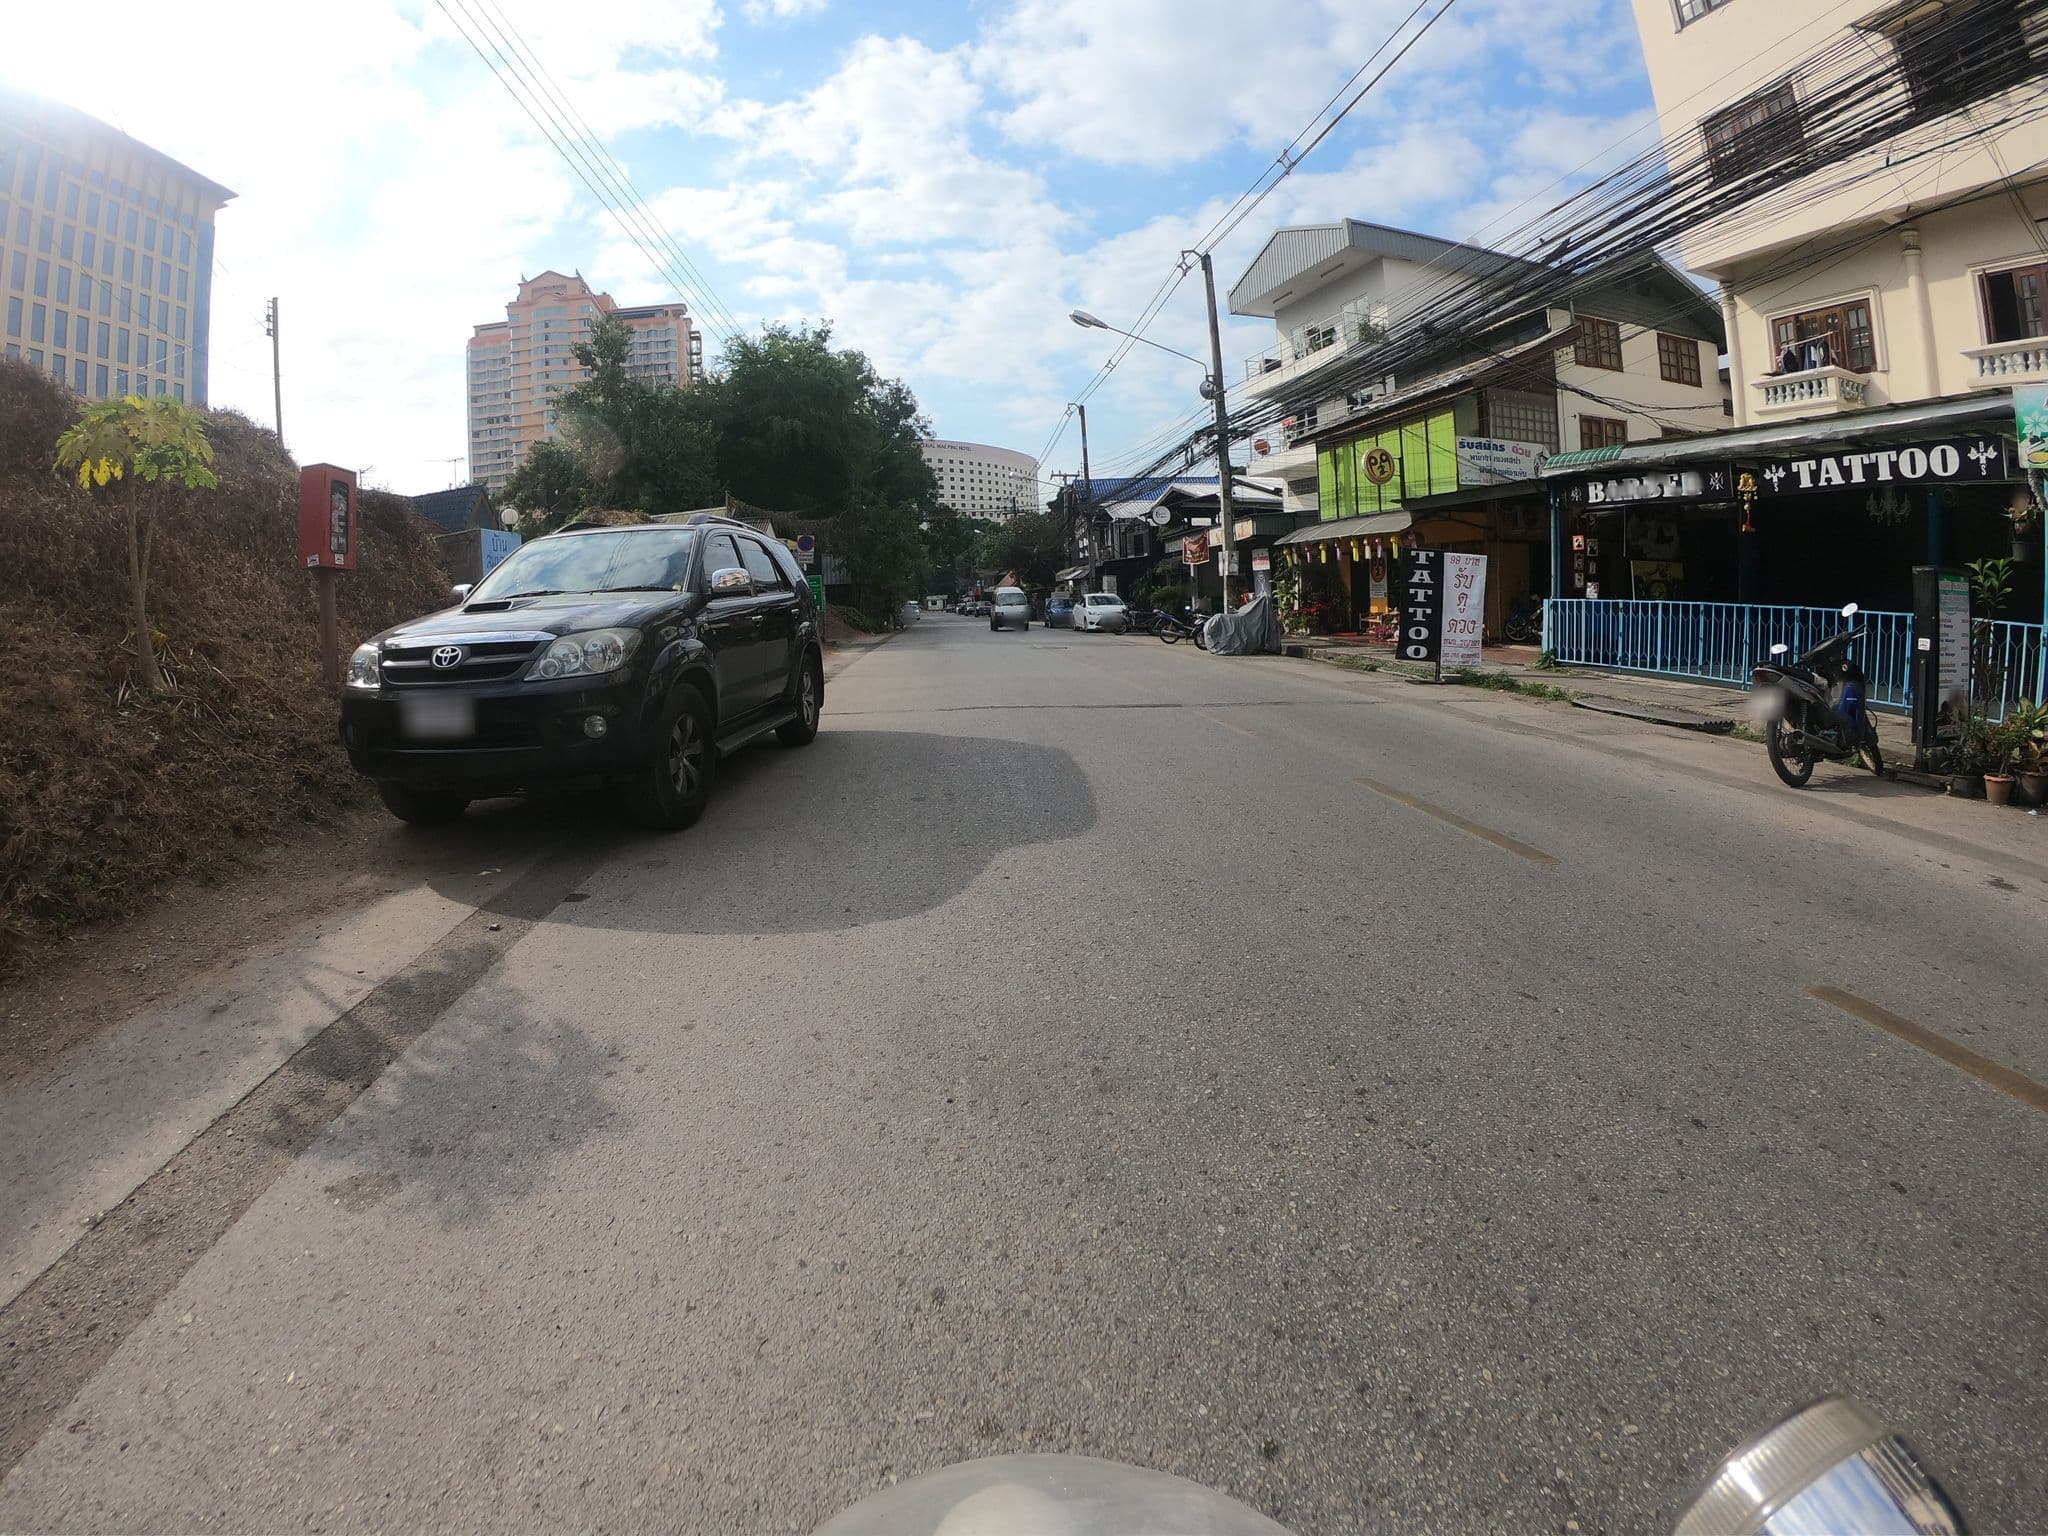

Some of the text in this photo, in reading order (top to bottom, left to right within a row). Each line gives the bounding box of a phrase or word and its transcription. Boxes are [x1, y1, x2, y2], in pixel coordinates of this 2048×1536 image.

[1511, 443, 1532, 458] ด่วน
[1792, 444, 1960, 489] TATTOO
[1453, 567, 1474, 589] รับ
[1406, 550, 1435, 659] TATTOO
[1457, 592, 1468, 614] ดู
[1447, 618, 1477, 634] ดวง
